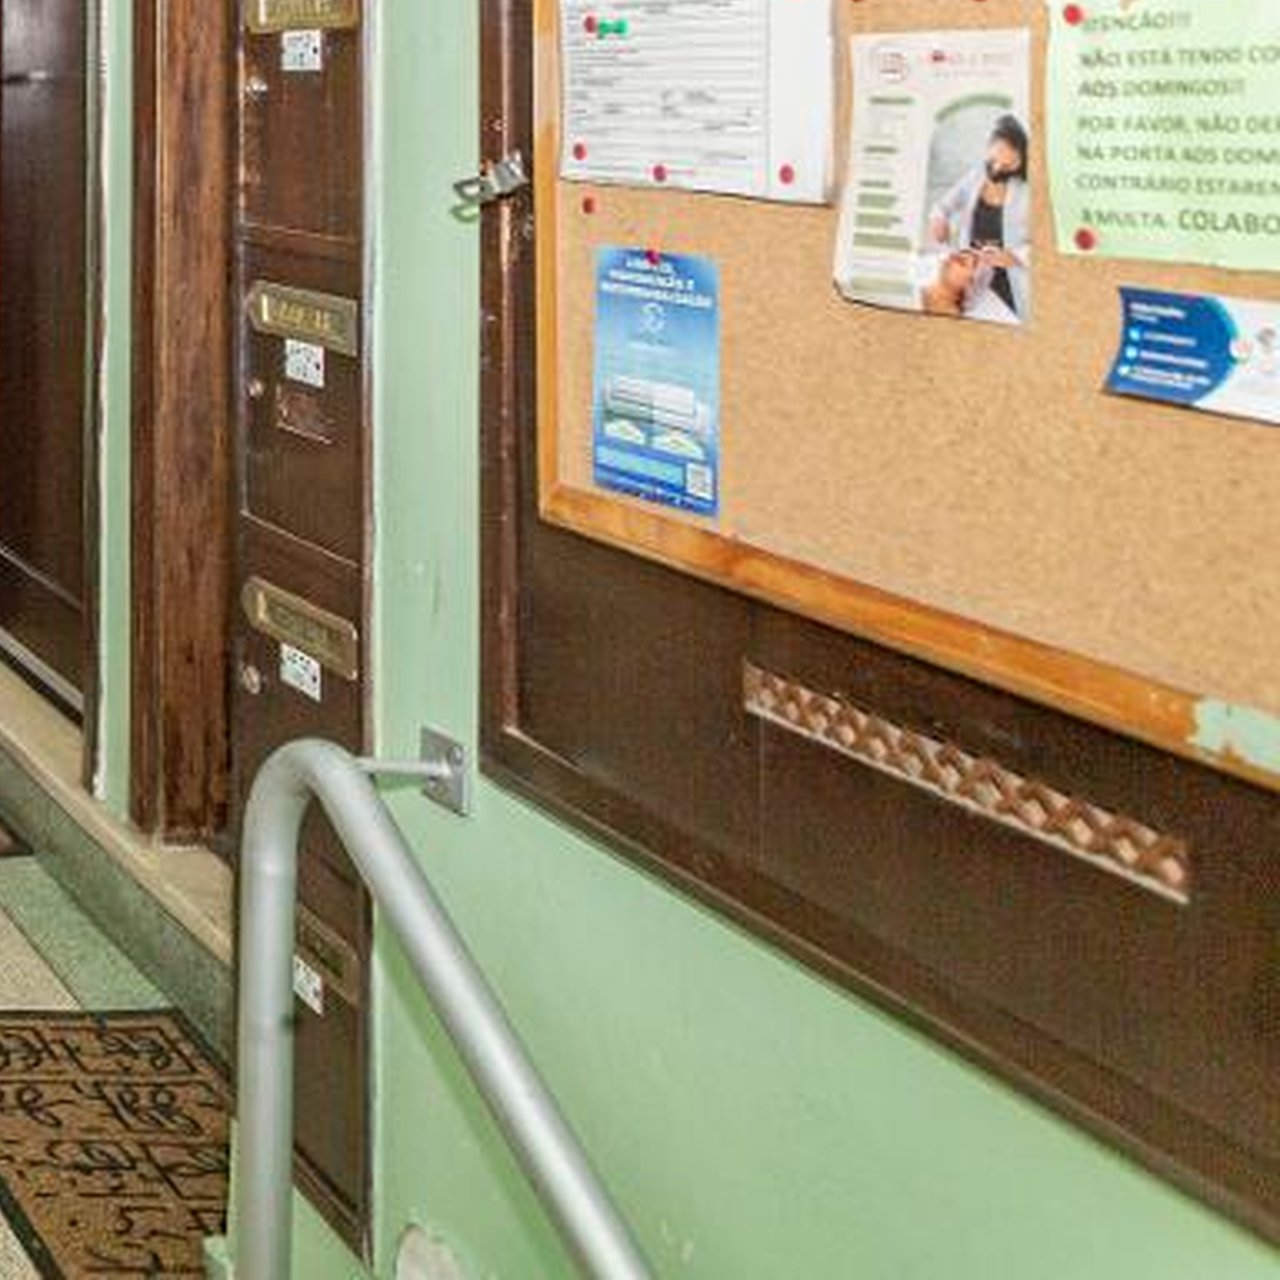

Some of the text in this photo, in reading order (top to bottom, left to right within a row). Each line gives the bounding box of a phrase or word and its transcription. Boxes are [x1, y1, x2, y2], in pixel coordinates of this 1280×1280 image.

[1079, 47, 1121, 67] NÃO
[1177, 46, 1242, 65] TENDO
[1077, 79, 1117, 98] AOS
[1078, 115, 1116, 132] POR
[1195, 113, 1239, 133] NÃO
[1110, 145, 1176, 162] PORTA
[1183, 147, 1218, 164] AOS
